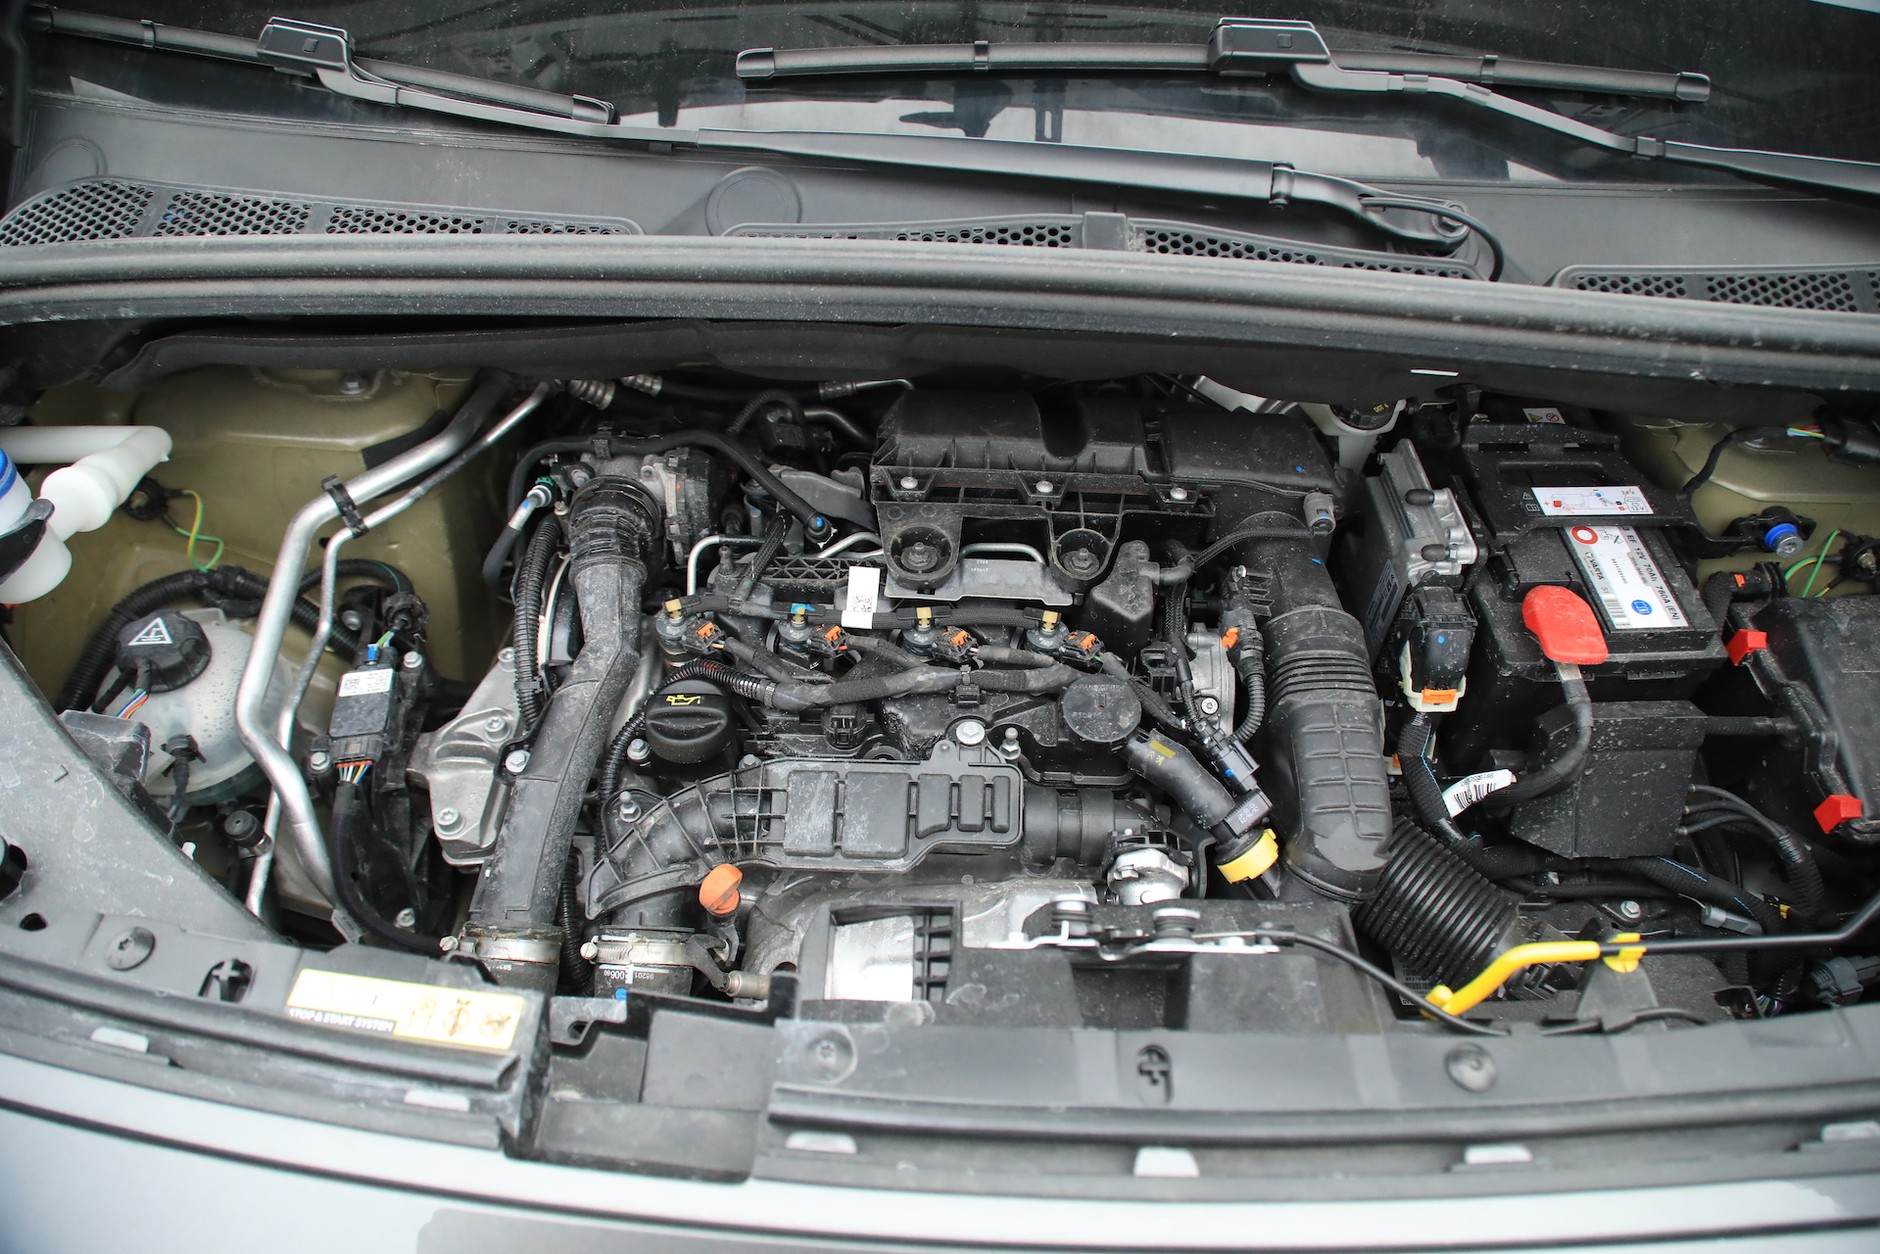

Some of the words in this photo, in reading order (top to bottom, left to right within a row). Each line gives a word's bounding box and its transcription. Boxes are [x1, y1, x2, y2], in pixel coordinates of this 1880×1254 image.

[1589, 559, 1605, 580] VARTA
[1635, 547, 1646, 561] 12V
[1656, 585, 1671, 604] 760A
[1666, 605, 1680, 620] (EN)
[289, 1007, 316, 1021] STOP
[323, 1012, 355, 1027] START
[354, 1016, 395, 1033] SYSTEM
